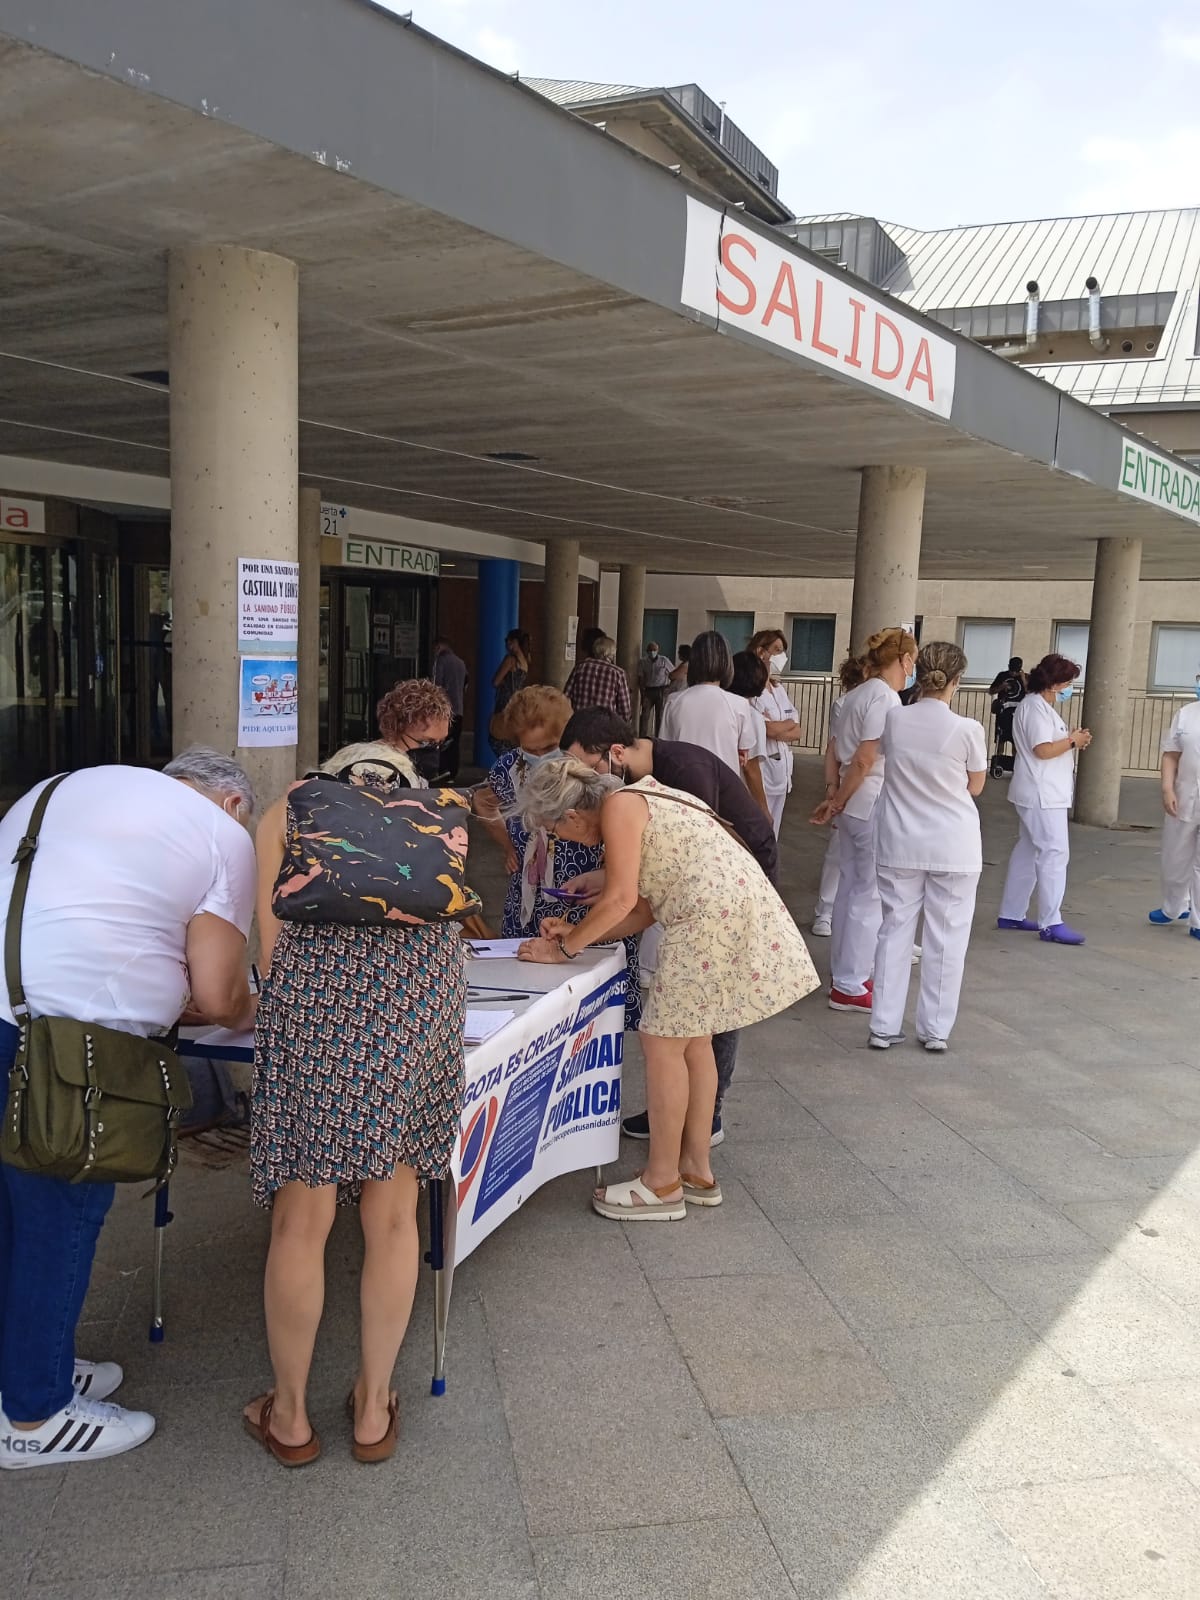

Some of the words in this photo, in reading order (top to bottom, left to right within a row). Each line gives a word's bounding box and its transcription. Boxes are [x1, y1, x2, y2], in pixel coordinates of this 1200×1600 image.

[716, 233, 935, 402] SALIDA
[1122, 446, 1200, 516] ENTRADA
[324, 517, 339, 536] 21
[242, 563, 259, 573] POR
[261, 564, 273, 574] UNA
[346, 542, 439, 574] ENTRADA
[242, 579, 278, 597] CASTILLA
[279, 581, 283, 598] Y
[243, 603, 251, 613] LA
[254, 603, 279, 614] SANIDAD
[242, 725, 260, 733] PIDE
[462, 1063, 503, 1110] GOTA
[504, 1048, 524, 1081] ES
[523, 1012, 574, 1065] CRUCIAL
[556, 1032, 624, 1093] SANIDAD
[543, 1078, 621, 1141] PÚBLICA
